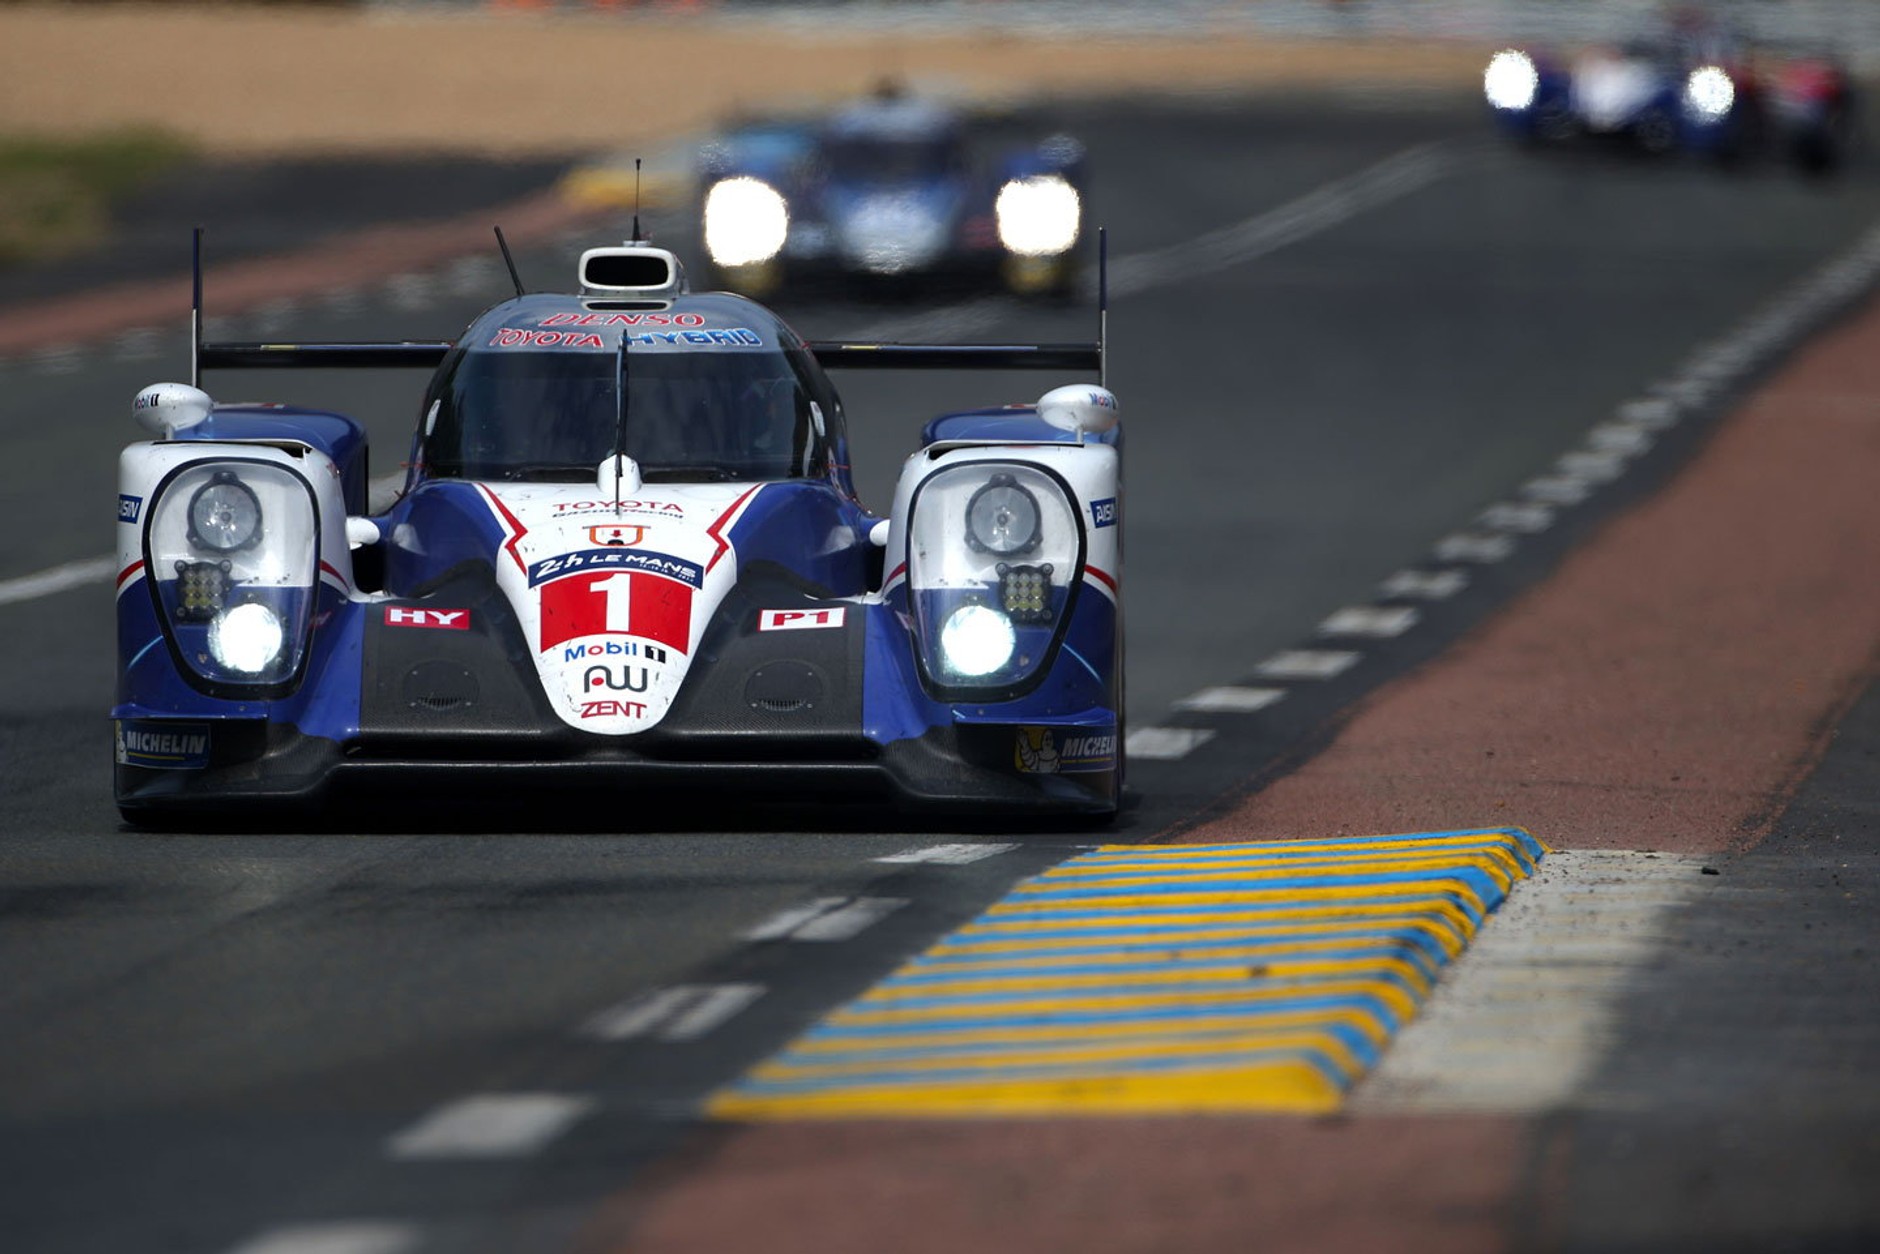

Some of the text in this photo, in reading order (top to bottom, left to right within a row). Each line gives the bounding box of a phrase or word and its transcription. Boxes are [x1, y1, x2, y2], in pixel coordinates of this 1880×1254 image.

[538, 313, 705, 328] DENSO
[489, 328, 763, 348] TOYOTA HYBRID
[553, 500, 684, 513] TOYOTA
[590, 554, 622, 564] LE
[626, 555, 696, 578] MANS
[590, 573, 630, 632] 1
[390, 609, 464, 625] HY
[773, 611, 829, 626] P1
[565, 642, 666, 664] Mobil 1
[581, 700, 647, 719] ZENT
[126, 731, 206, 754] MICHELIN
